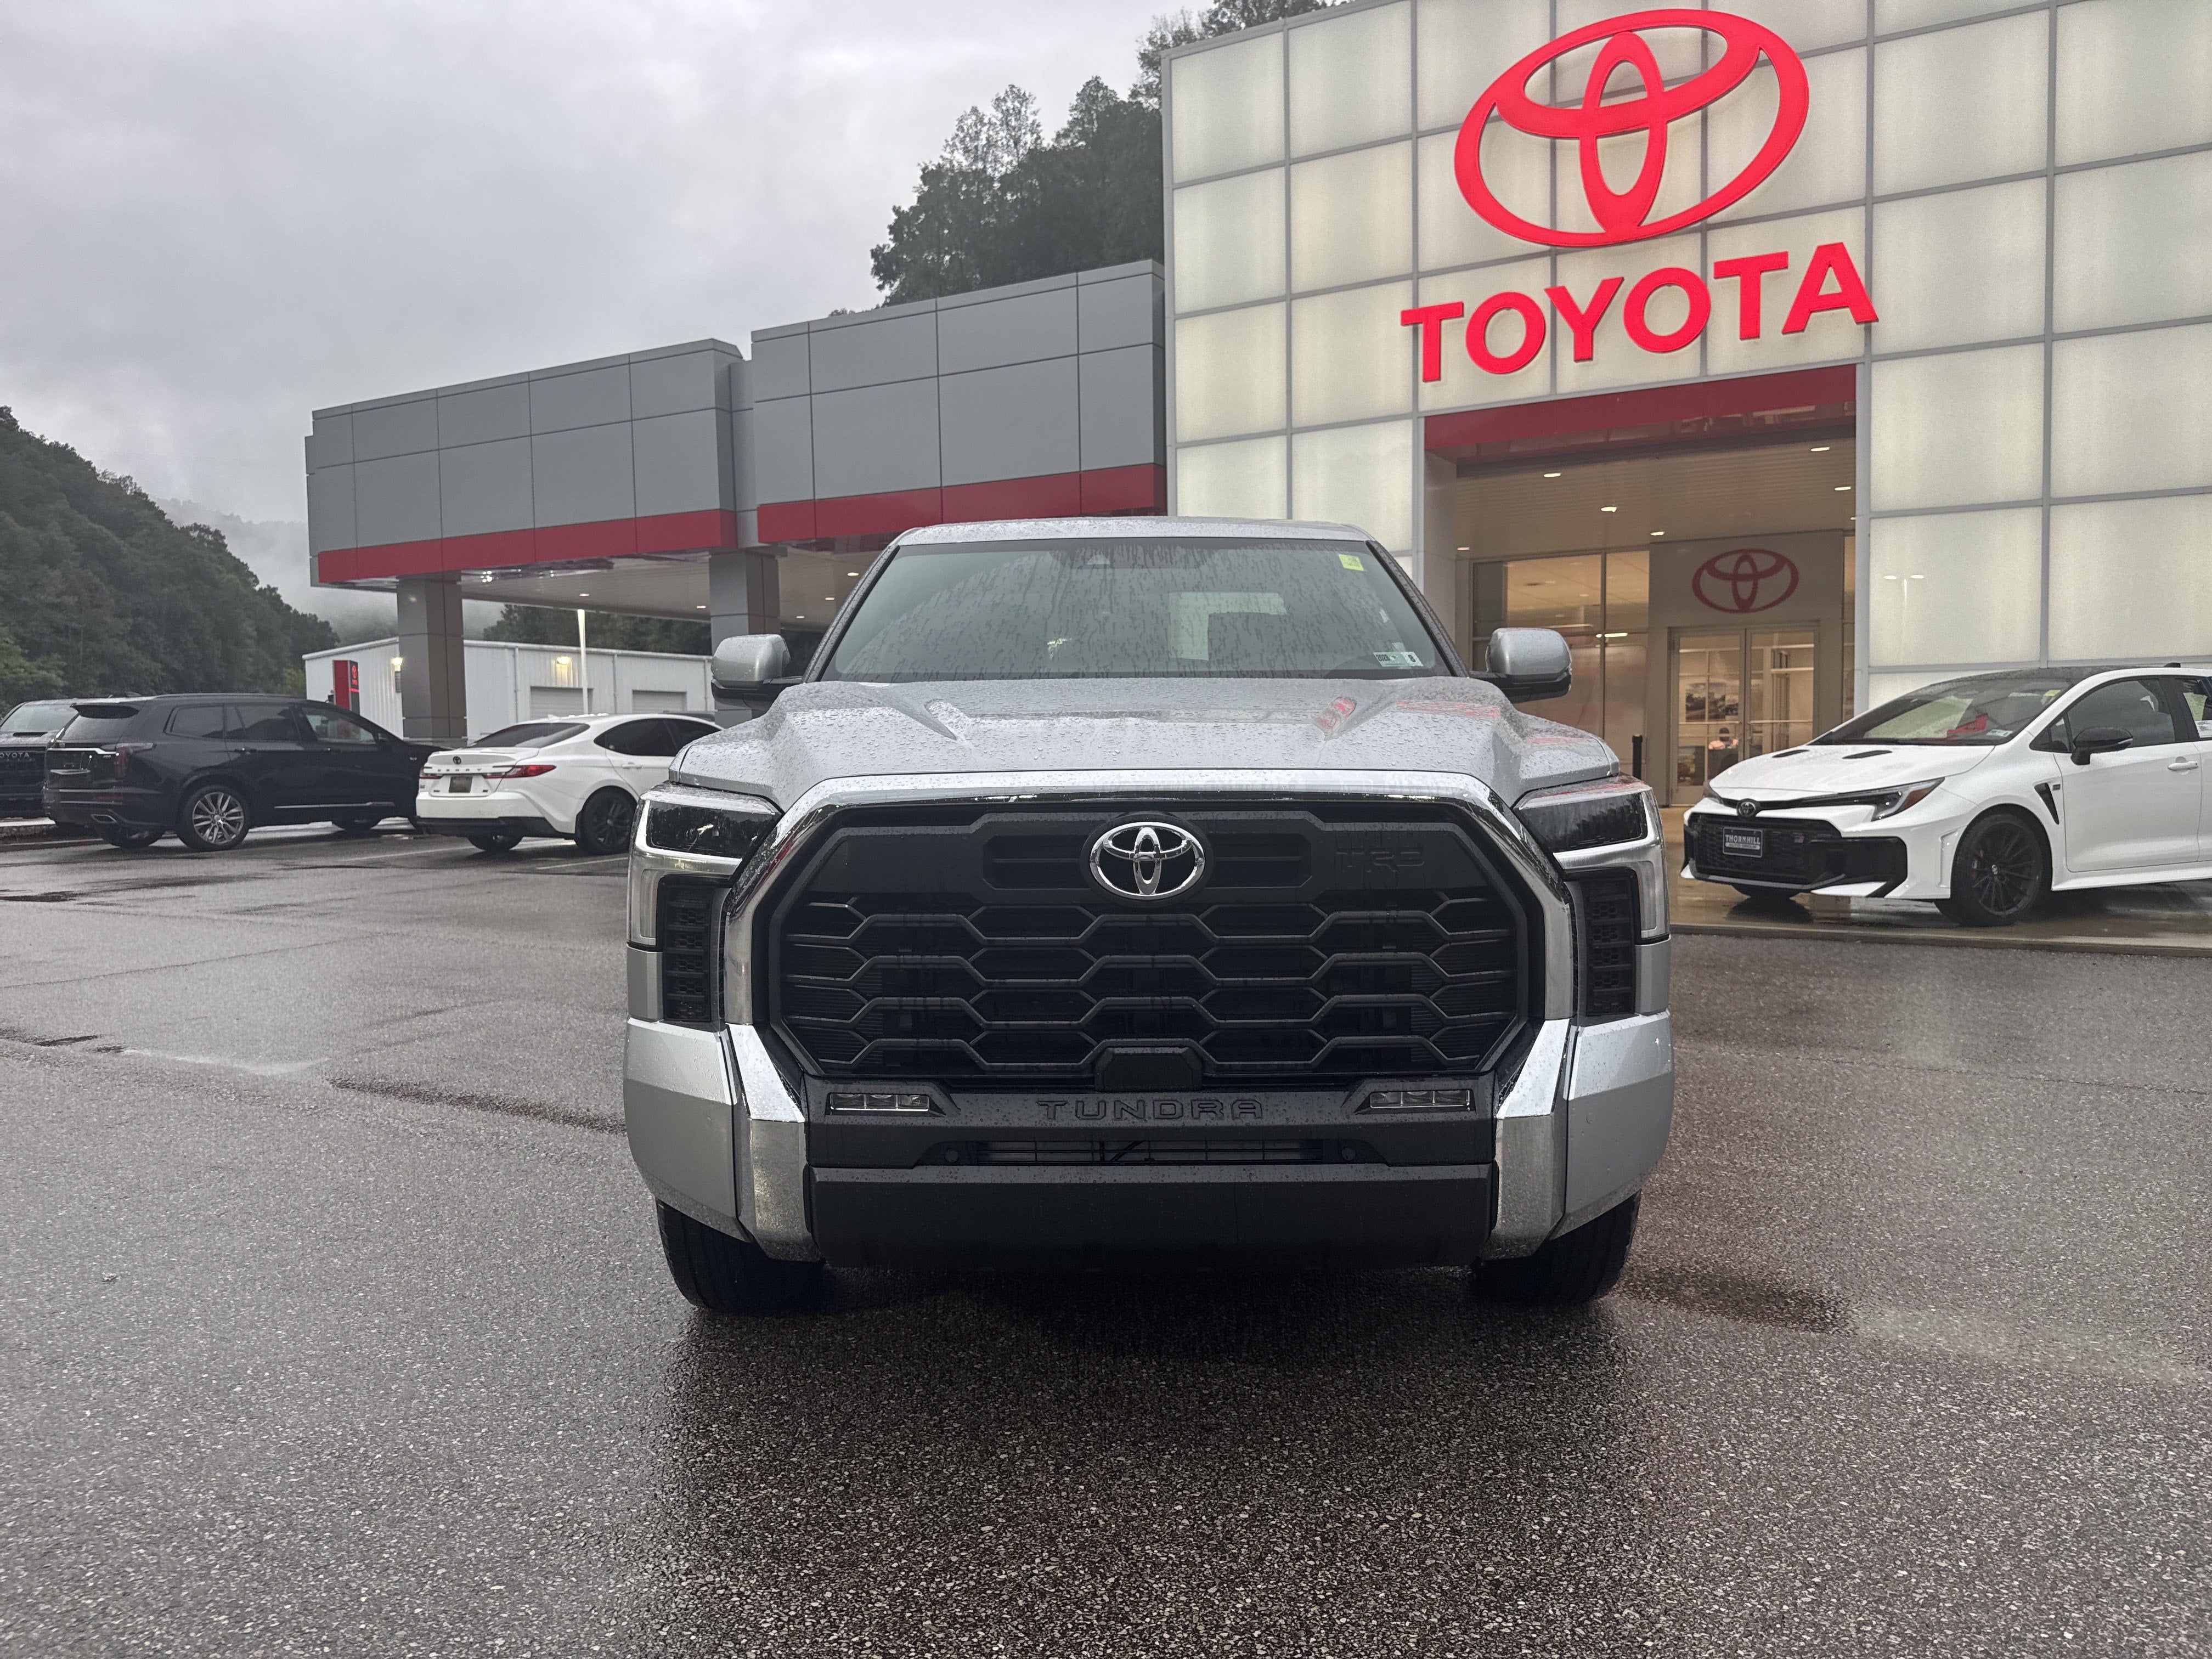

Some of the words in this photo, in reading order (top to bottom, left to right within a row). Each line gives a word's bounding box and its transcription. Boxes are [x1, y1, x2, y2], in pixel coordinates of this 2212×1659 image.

[1401, 242, 1879, 382] TOYOTA
[1407, 654, 1416, 663] 8
[1725, 834, 1760, 845] THORNHILL
[1036, 1099, 1263, 1121] TUNDRA
